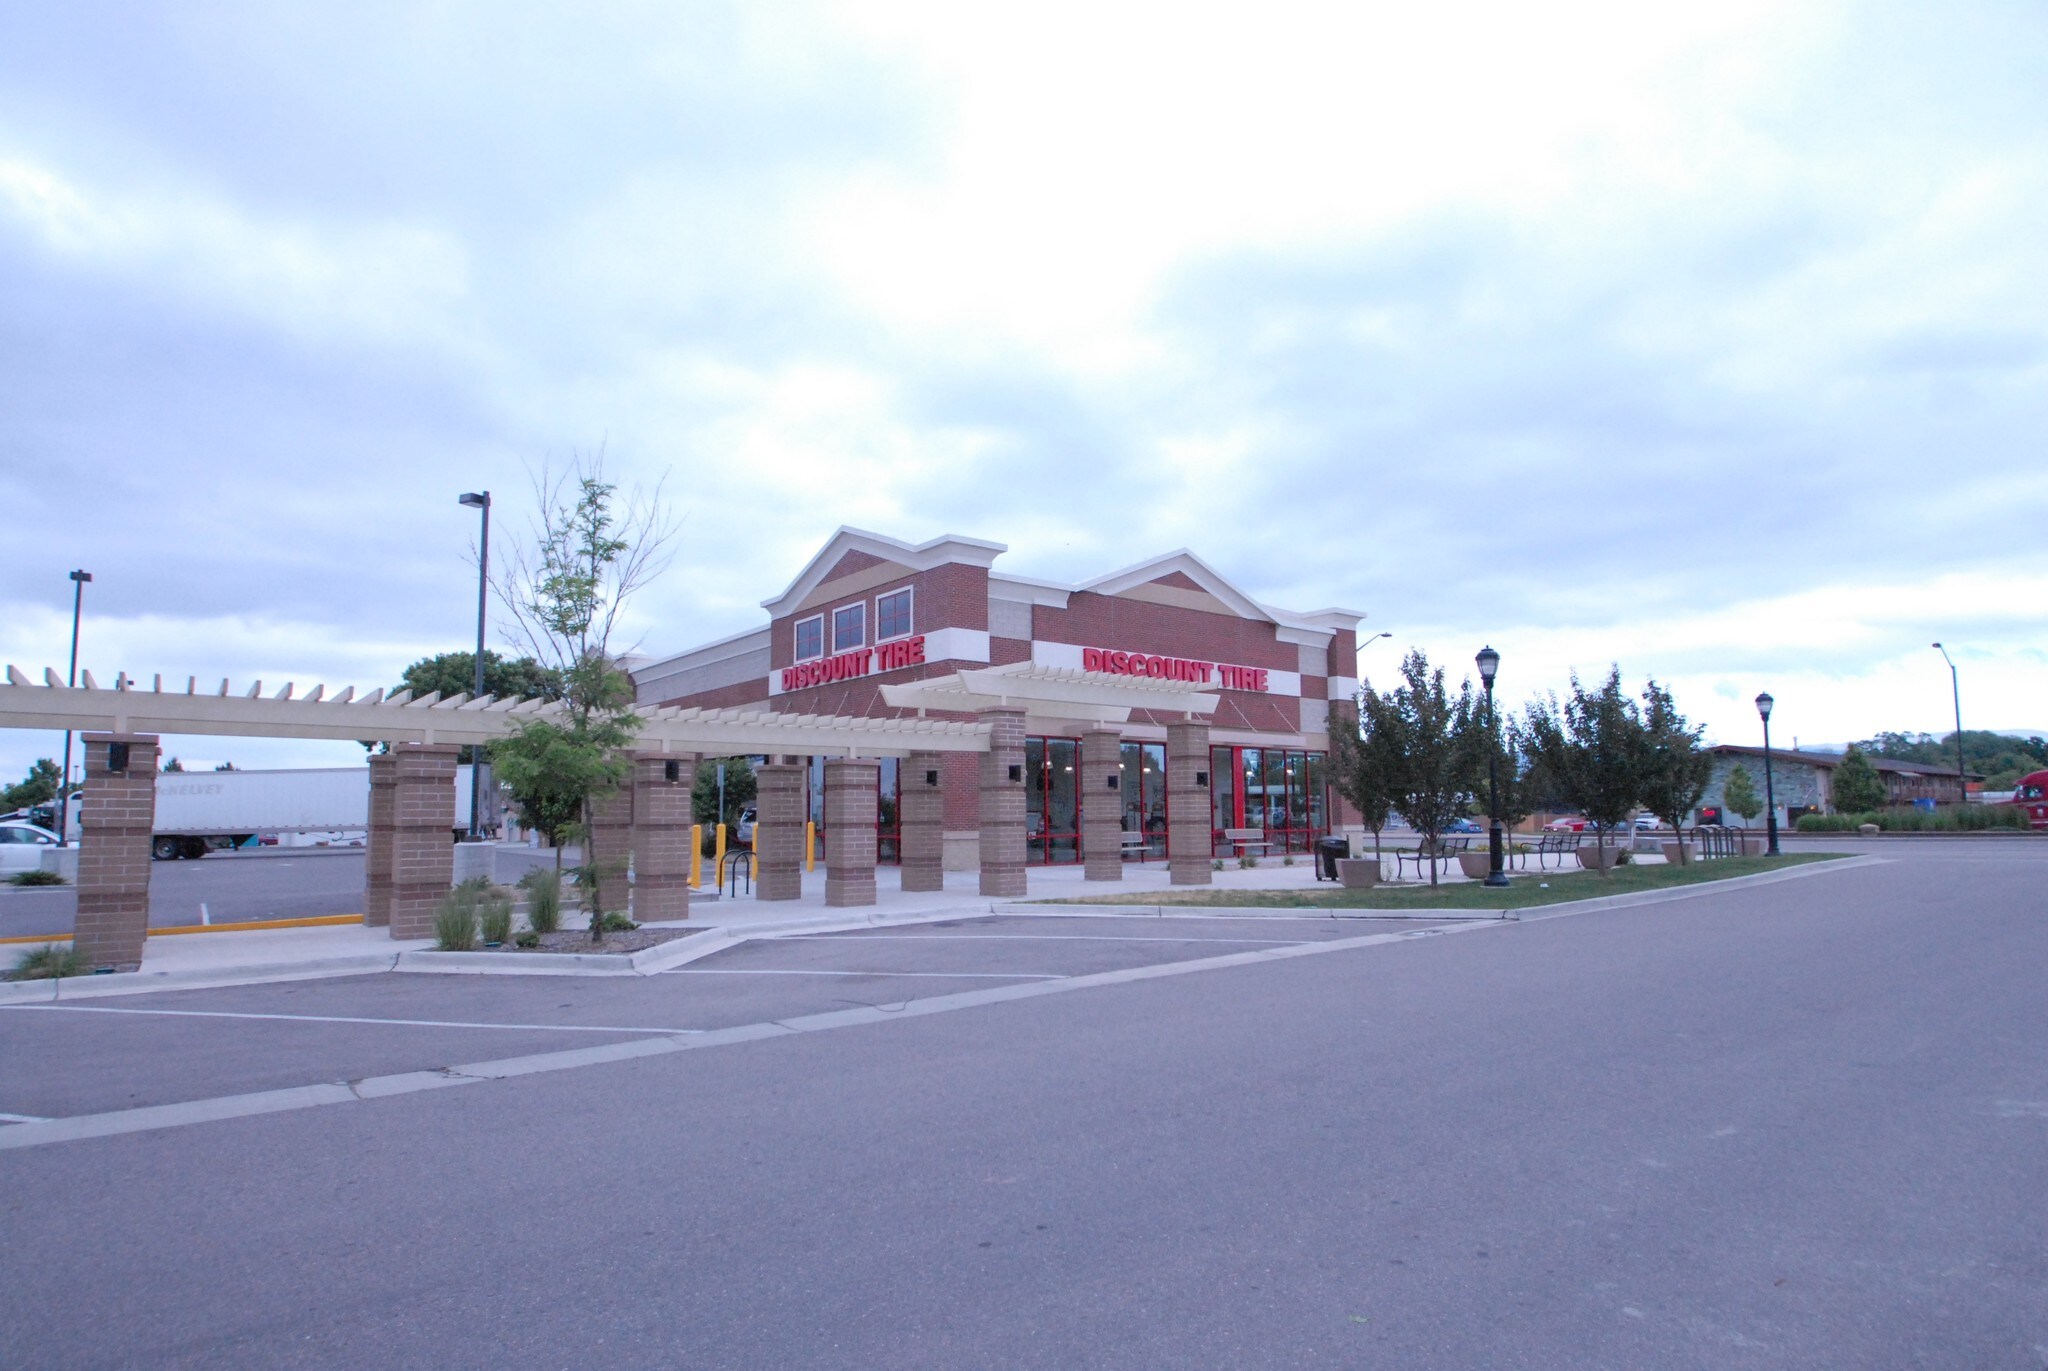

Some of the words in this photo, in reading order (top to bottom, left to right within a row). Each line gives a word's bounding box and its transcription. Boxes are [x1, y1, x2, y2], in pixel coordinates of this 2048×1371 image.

[781, 648, 872, 691] DISCOUNT
[875, 636, 925, 671] TIRE
[1083, 646, 1214, 682] DISCOUNT
[1218, 665, 1268, 691] TIRE
